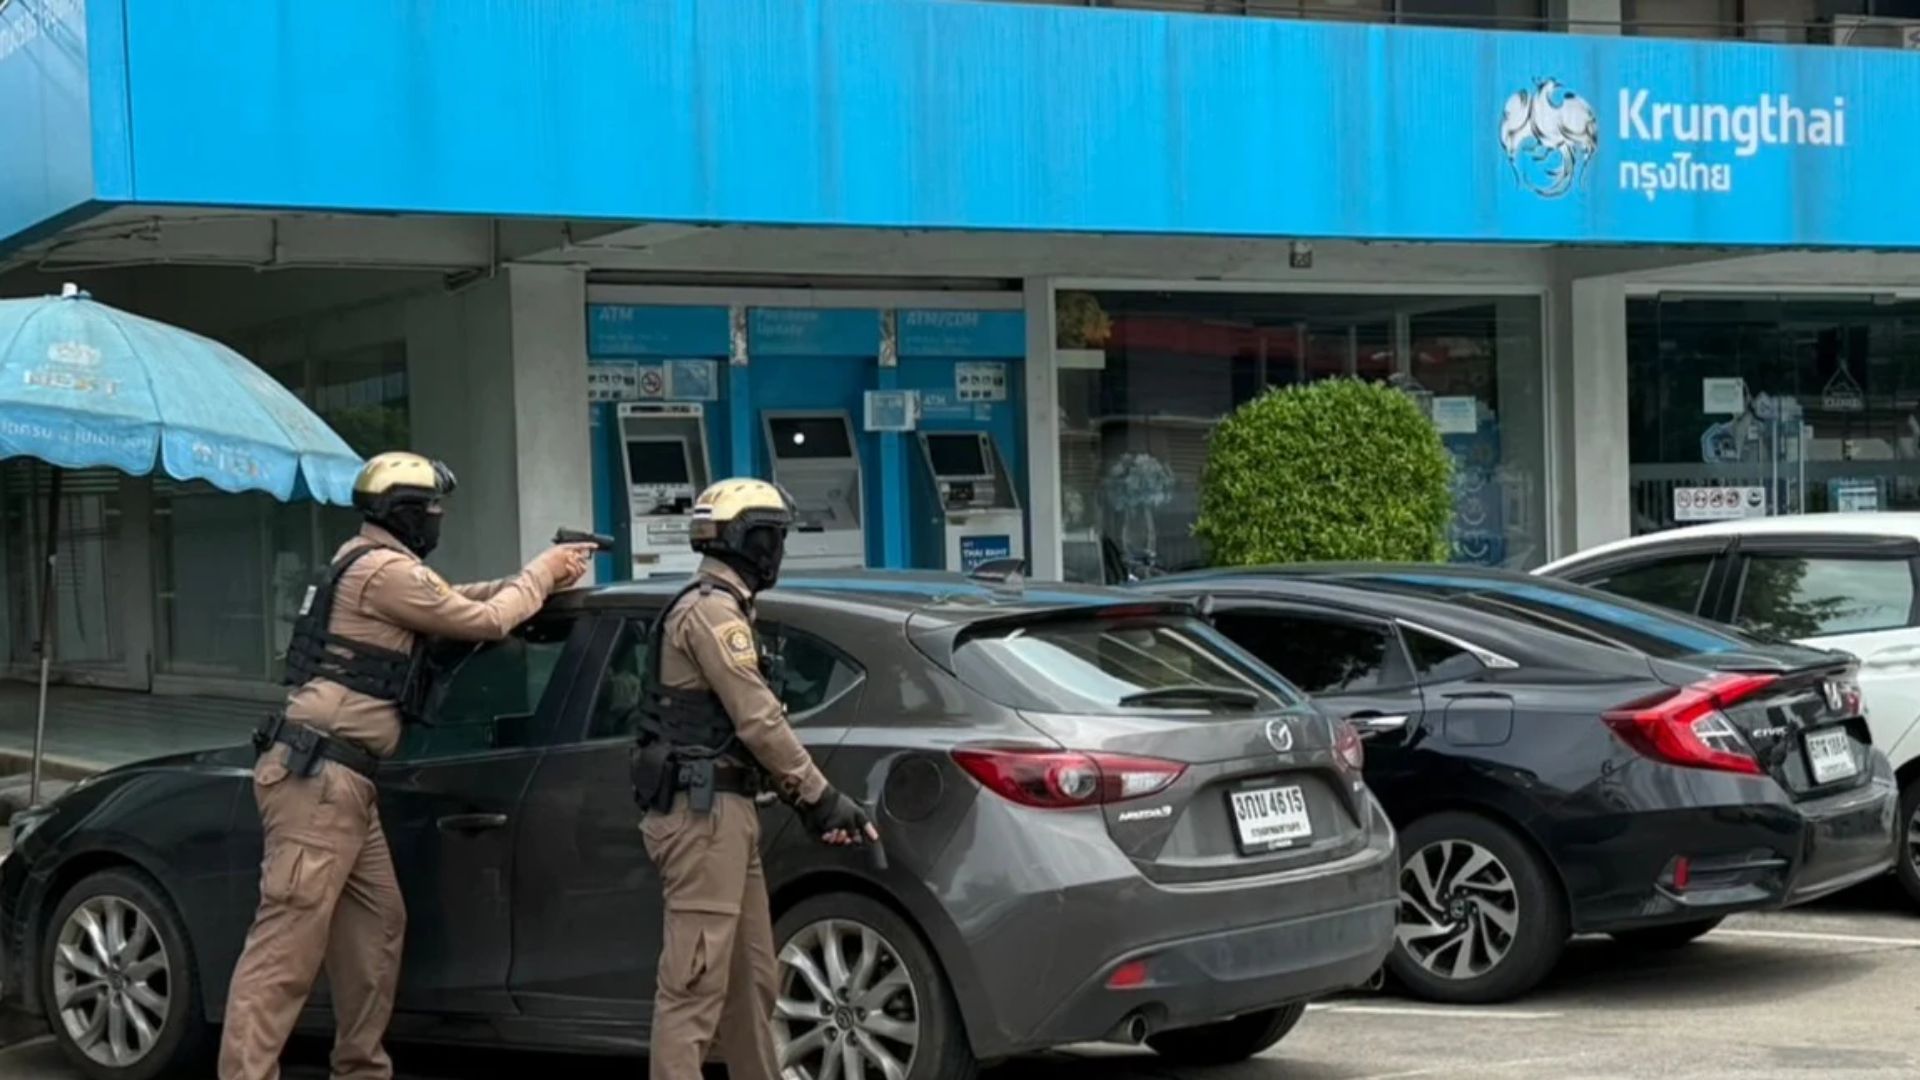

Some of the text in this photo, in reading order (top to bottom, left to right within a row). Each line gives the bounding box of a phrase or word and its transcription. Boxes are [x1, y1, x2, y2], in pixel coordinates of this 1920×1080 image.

[1619, 88, 1845, 156] Krungthai
[1619, 153, 1731, 201] กรุงไทย
[600, 307, 633, 321] ATM
[1269, 788, 1303, 815] 4615
